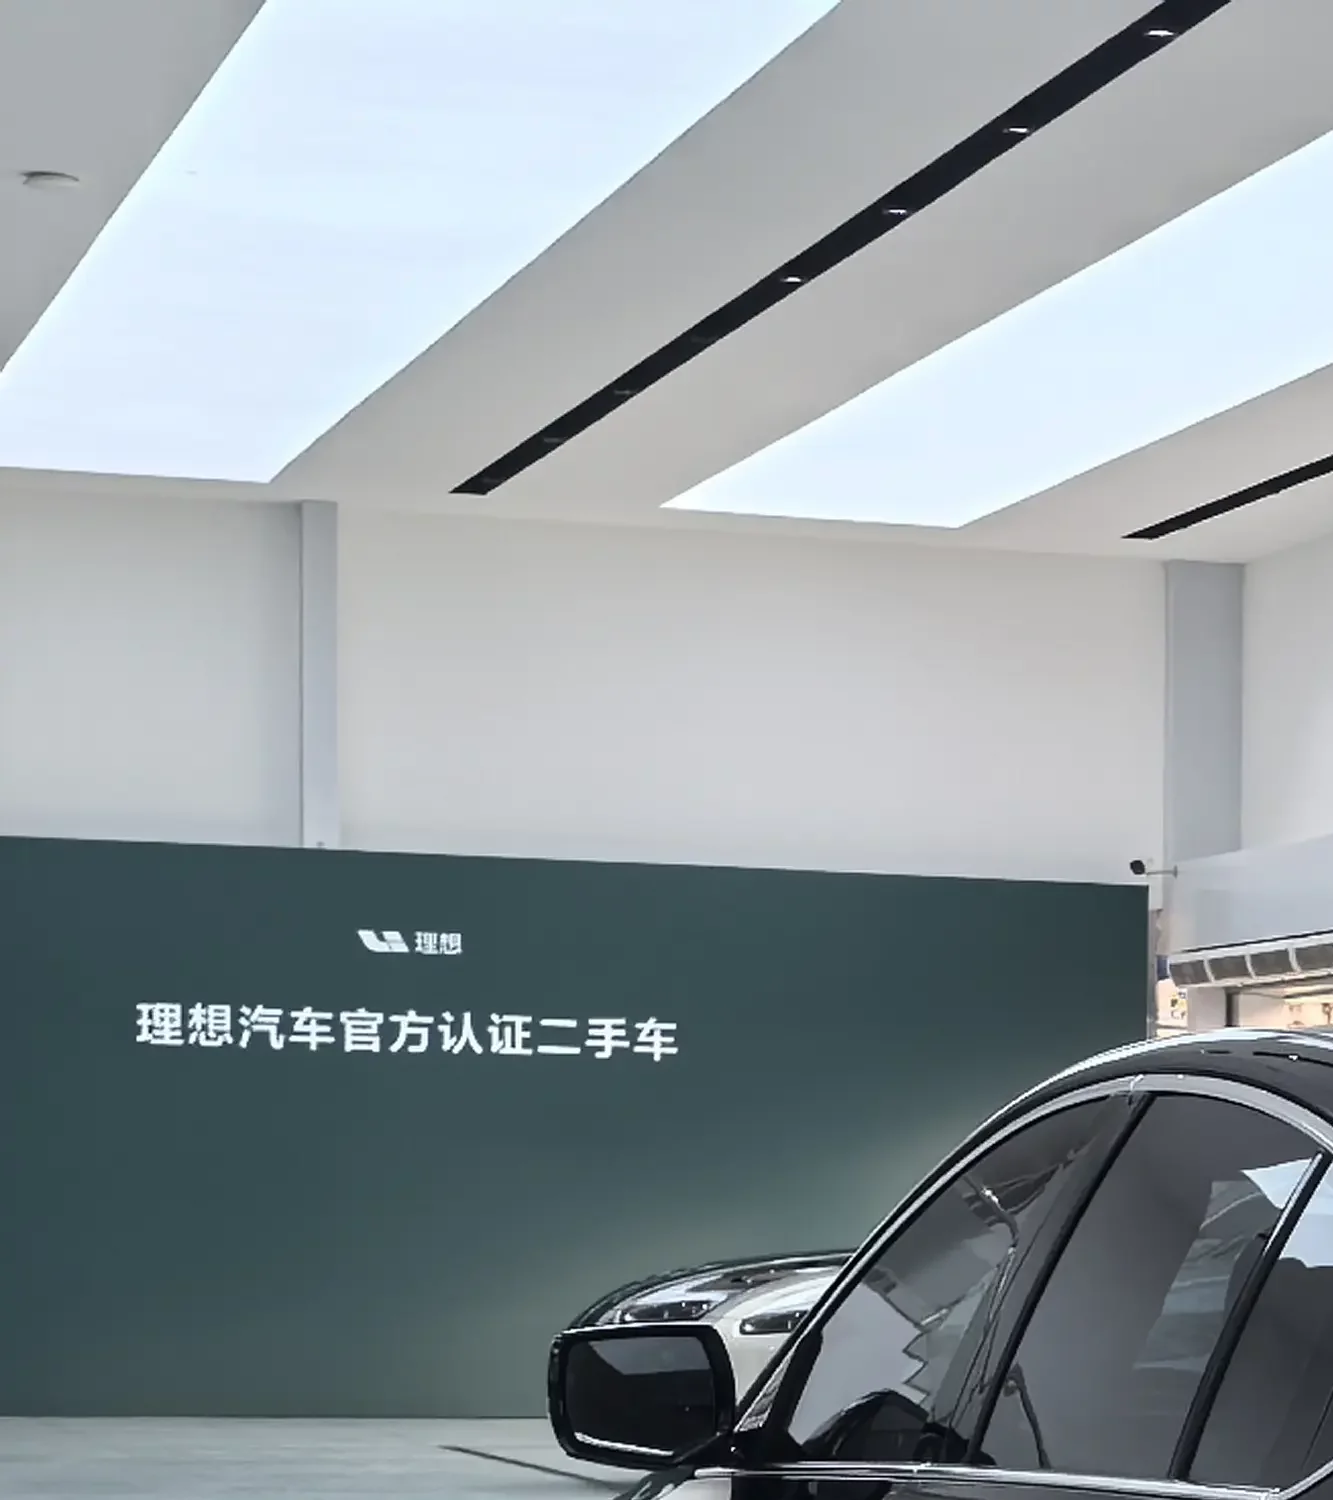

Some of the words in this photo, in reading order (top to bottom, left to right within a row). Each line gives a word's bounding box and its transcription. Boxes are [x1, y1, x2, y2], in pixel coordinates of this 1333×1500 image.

[414, 931, 463, 955] 理想
[134, 1001, 679, 1062] 理想汽车官方认证二手车
